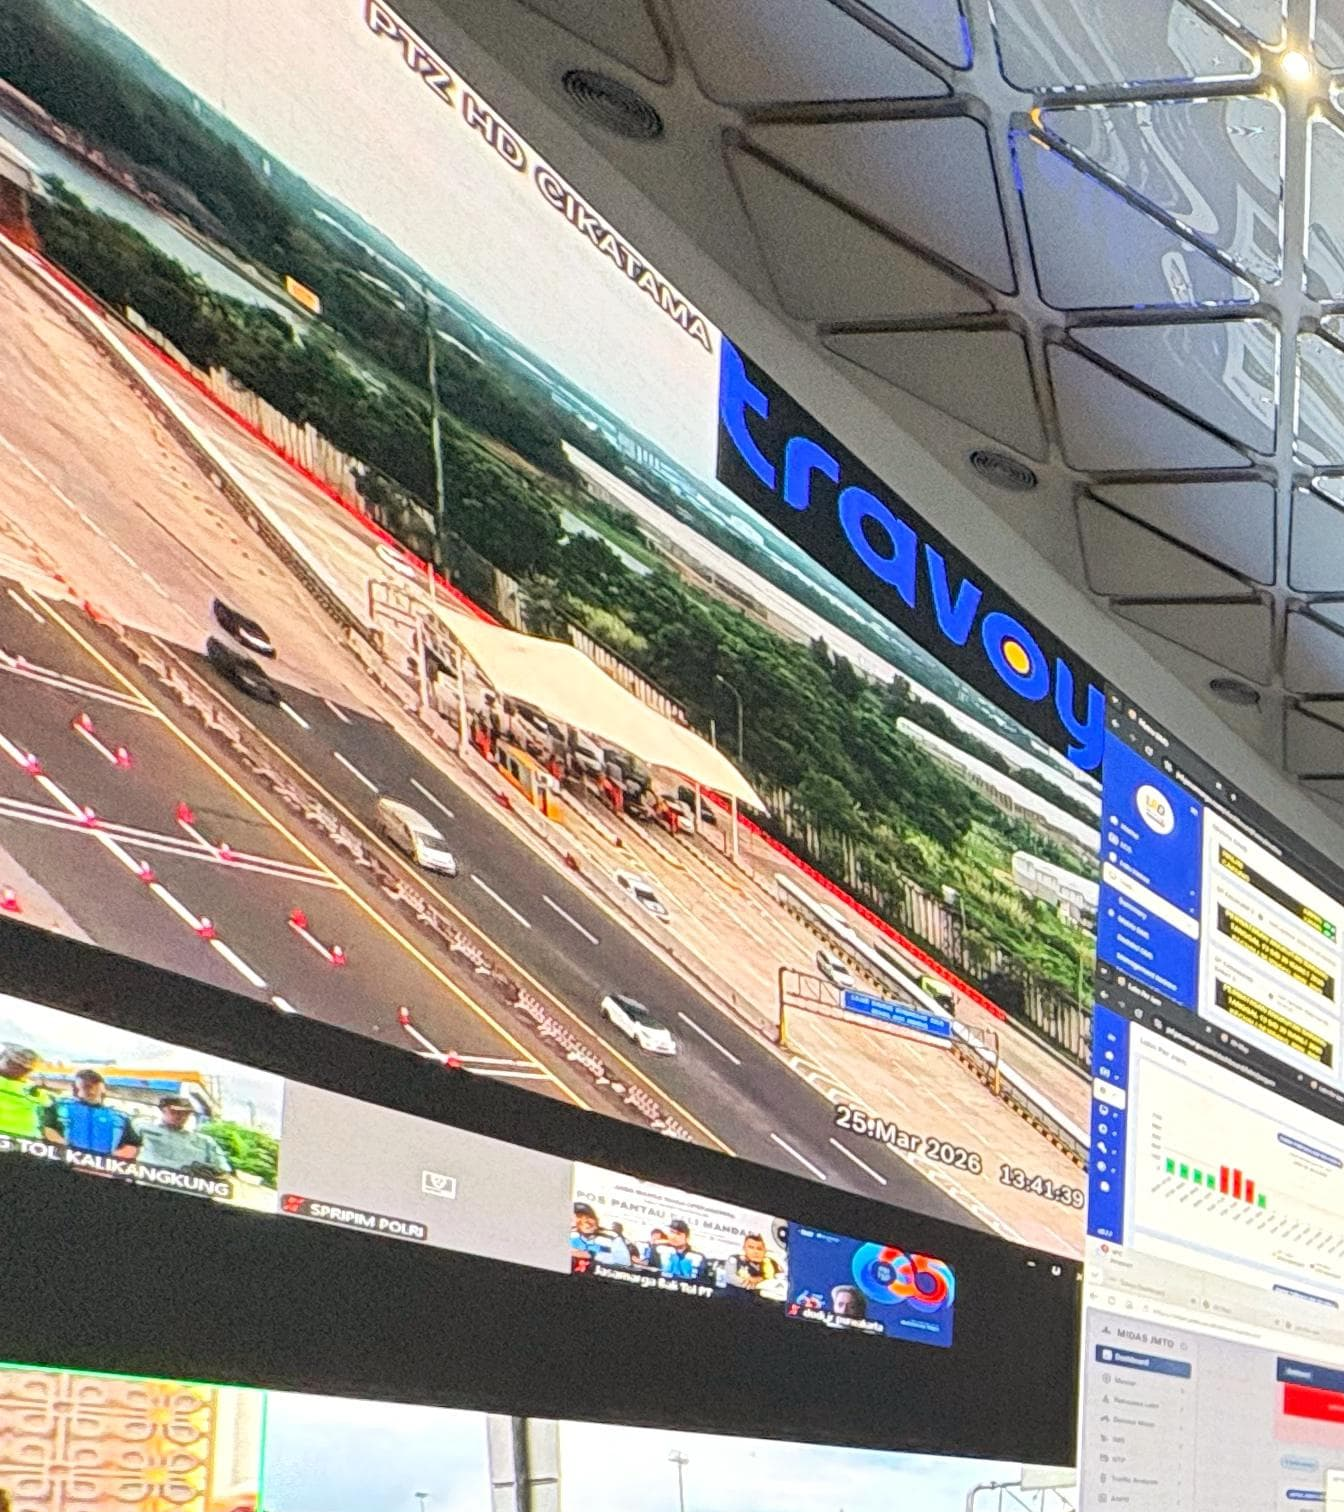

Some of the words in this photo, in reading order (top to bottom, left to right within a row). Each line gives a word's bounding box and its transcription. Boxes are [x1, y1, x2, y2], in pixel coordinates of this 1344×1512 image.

[365, 0, 457, 107] PTZ
[462, 91, 528, 173] HD
[534, 165, 714, 354] CIKATAMA
[720, 335, 1106, 770] travoy
[17, 1138, 61, 1161] TOL
[66, 1149, 230, 1196] KALIKANGKUNG
[926, 1138, 983, 1175] 2026
[1000, 1164, 1085, 1209] 13:41:39
[310, 1203, 376, 1229] SPRIPIM
[379, 1219, 424, 1239] POLRI
[1117, 1327, 1149, 1344] MIDAS
